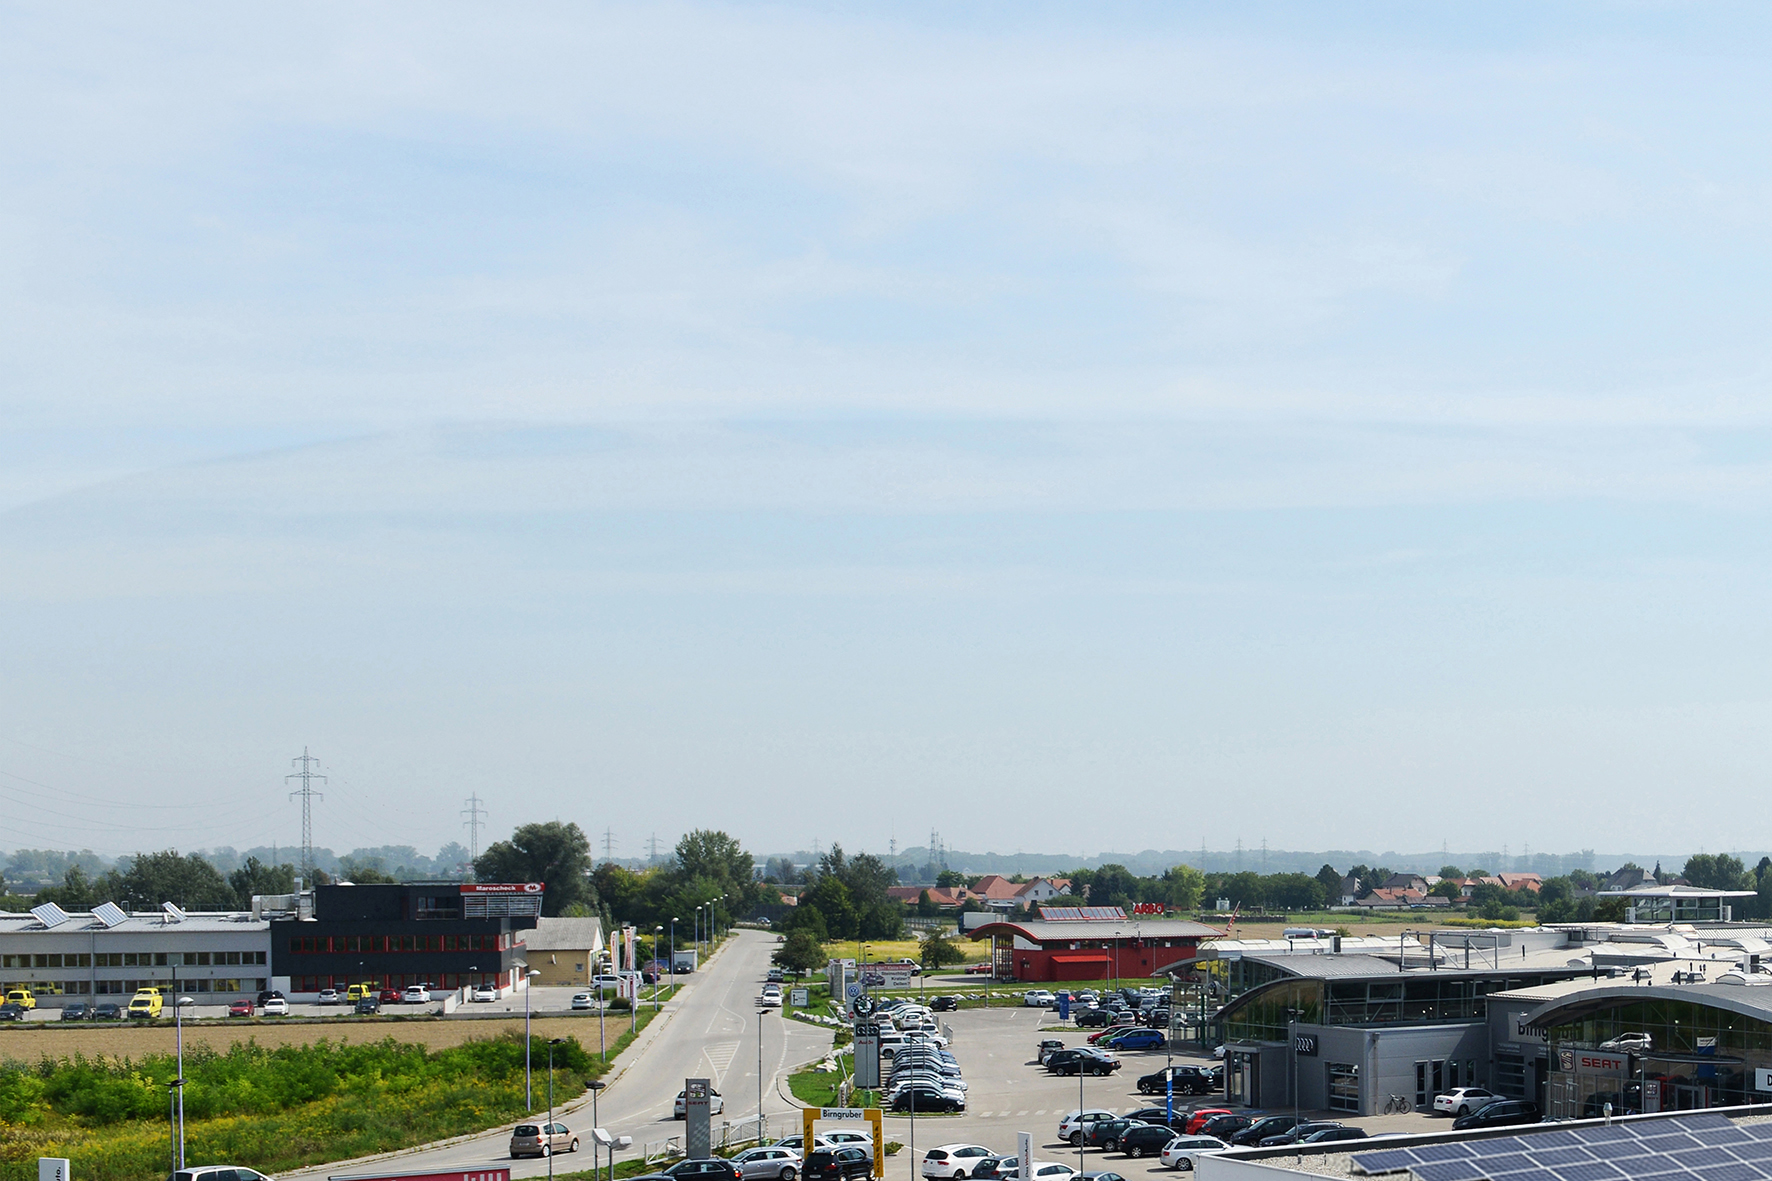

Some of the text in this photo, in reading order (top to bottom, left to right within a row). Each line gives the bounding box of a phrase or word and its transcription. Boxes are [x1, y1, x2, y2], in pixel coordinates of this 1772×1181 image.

[1133, 902, 1164, 915] ARBO
[1581, 1057, 1622, 1070] SEAT
[822, 1109, 862, 1120] Birngruber
